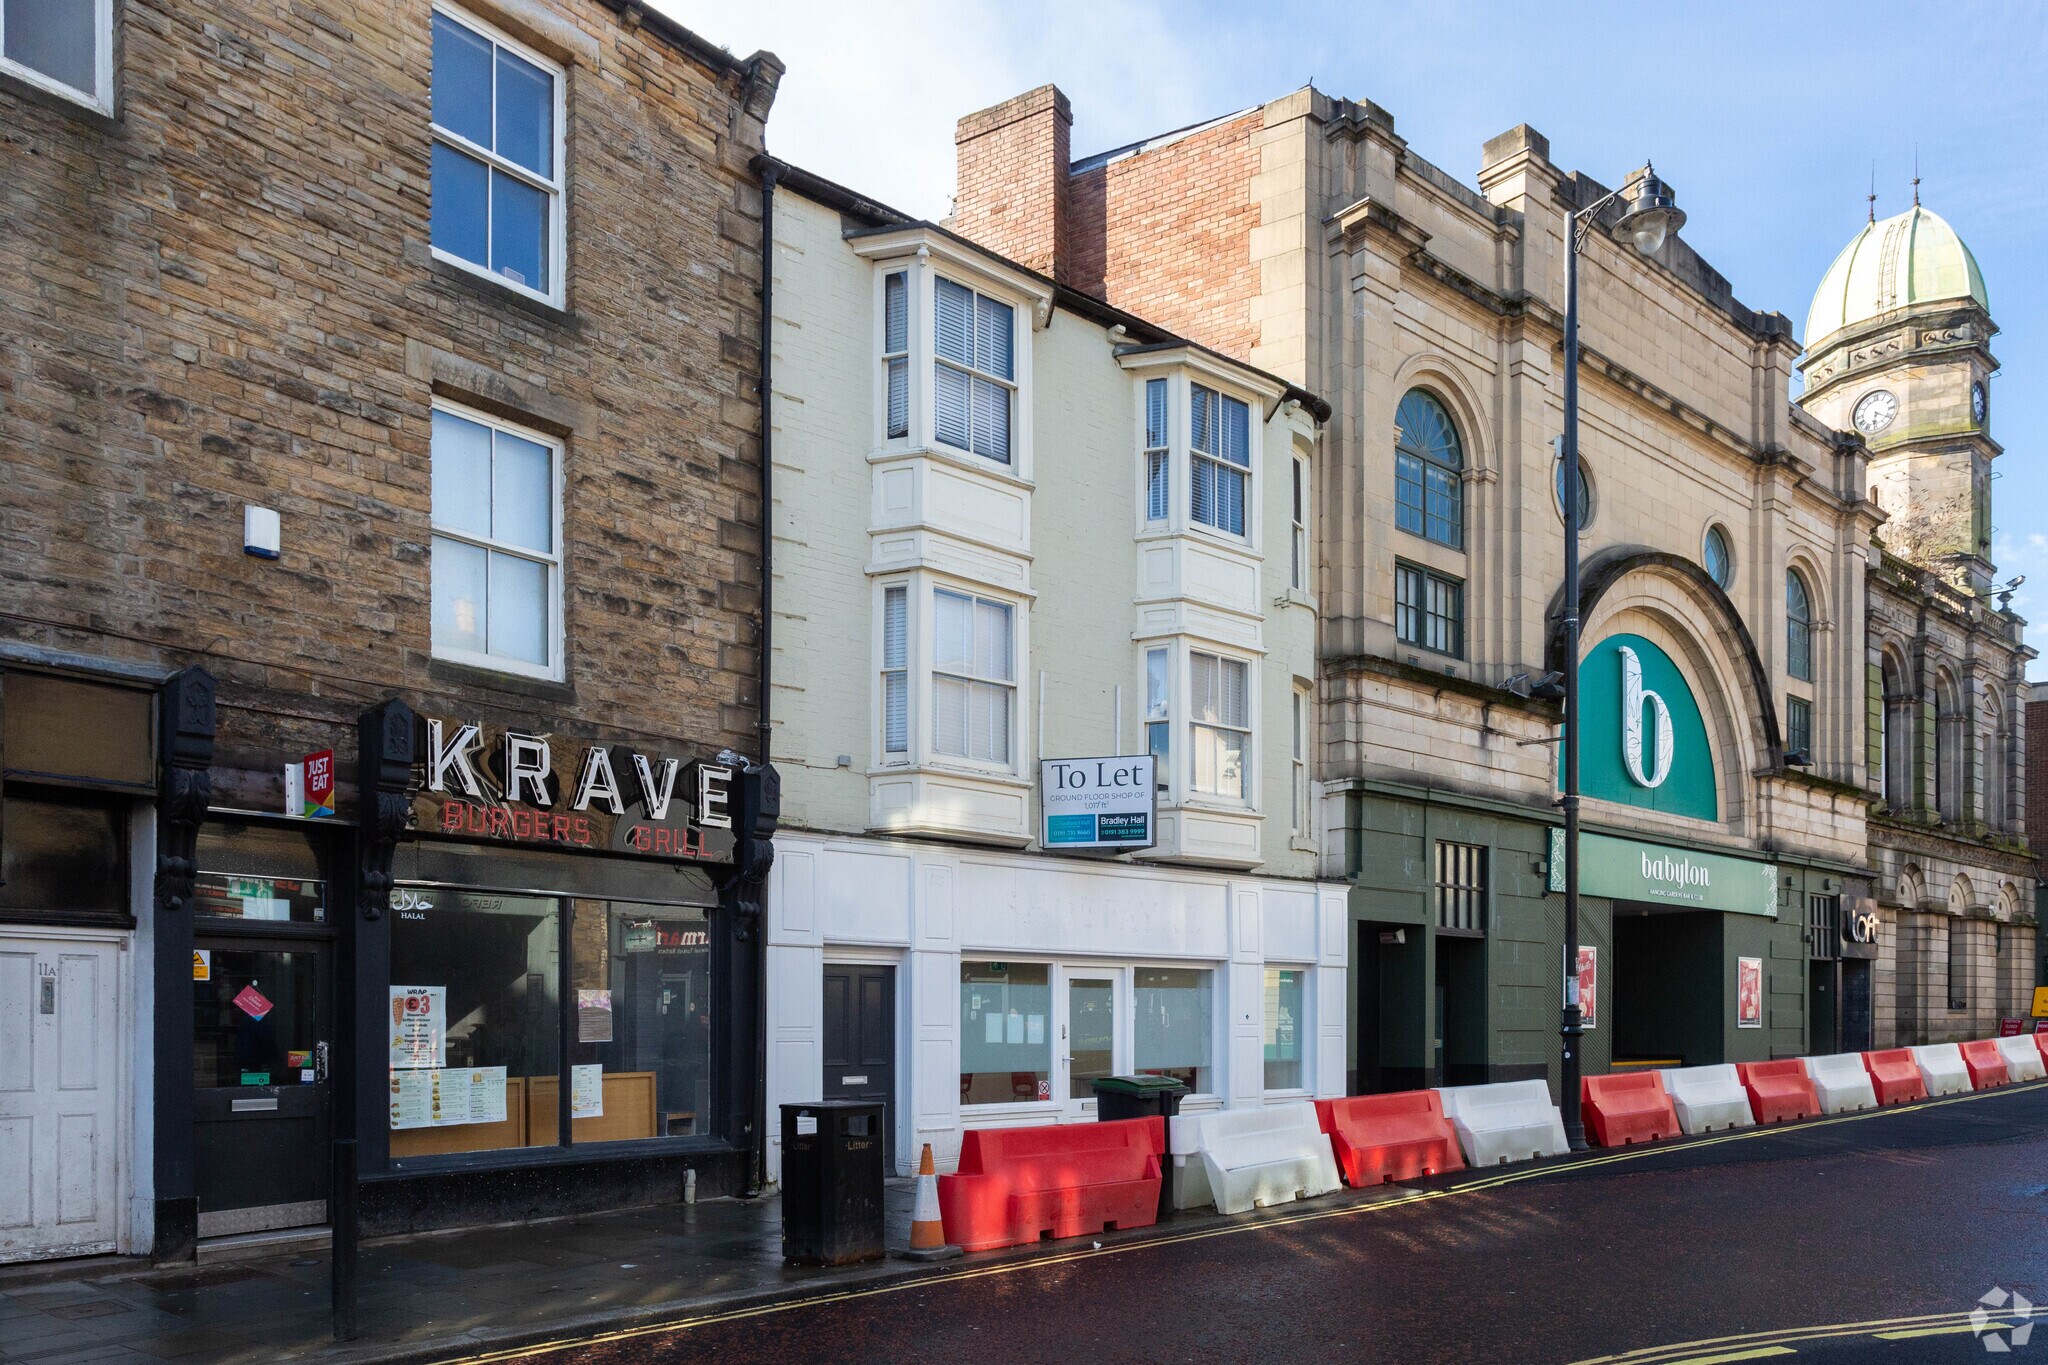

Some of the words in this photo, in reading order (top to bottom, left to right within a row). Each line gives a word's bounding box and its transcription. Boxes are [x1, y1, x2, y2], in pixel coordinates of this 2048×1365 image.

[308, 757, 329, 779] JUST
[428, 719, 732, 829] KRAVE
[1051, 764, 1086, 789] To
[1096, 762, 1144, 787] Let
[312, 773, 329, 791] EAT
[1050, 794, 1083, 802] GROUND
[1111, 792, 1133, 800] SHOP
[1134, 791, 1145, 799] OF
[443, 800, 591, 844] BURGERS
[634, 825, 713, 857] GRILL
[1100, 816, 1129, 827] Bradley
[1130, 815, 1145, 824] Hall
[1641, 850, 1711, 889] babylon
[393, 889, 434, 911] حلال
[401, 912, 425, 920] HALAL
[847, 1141, 870, 1151] Litter
